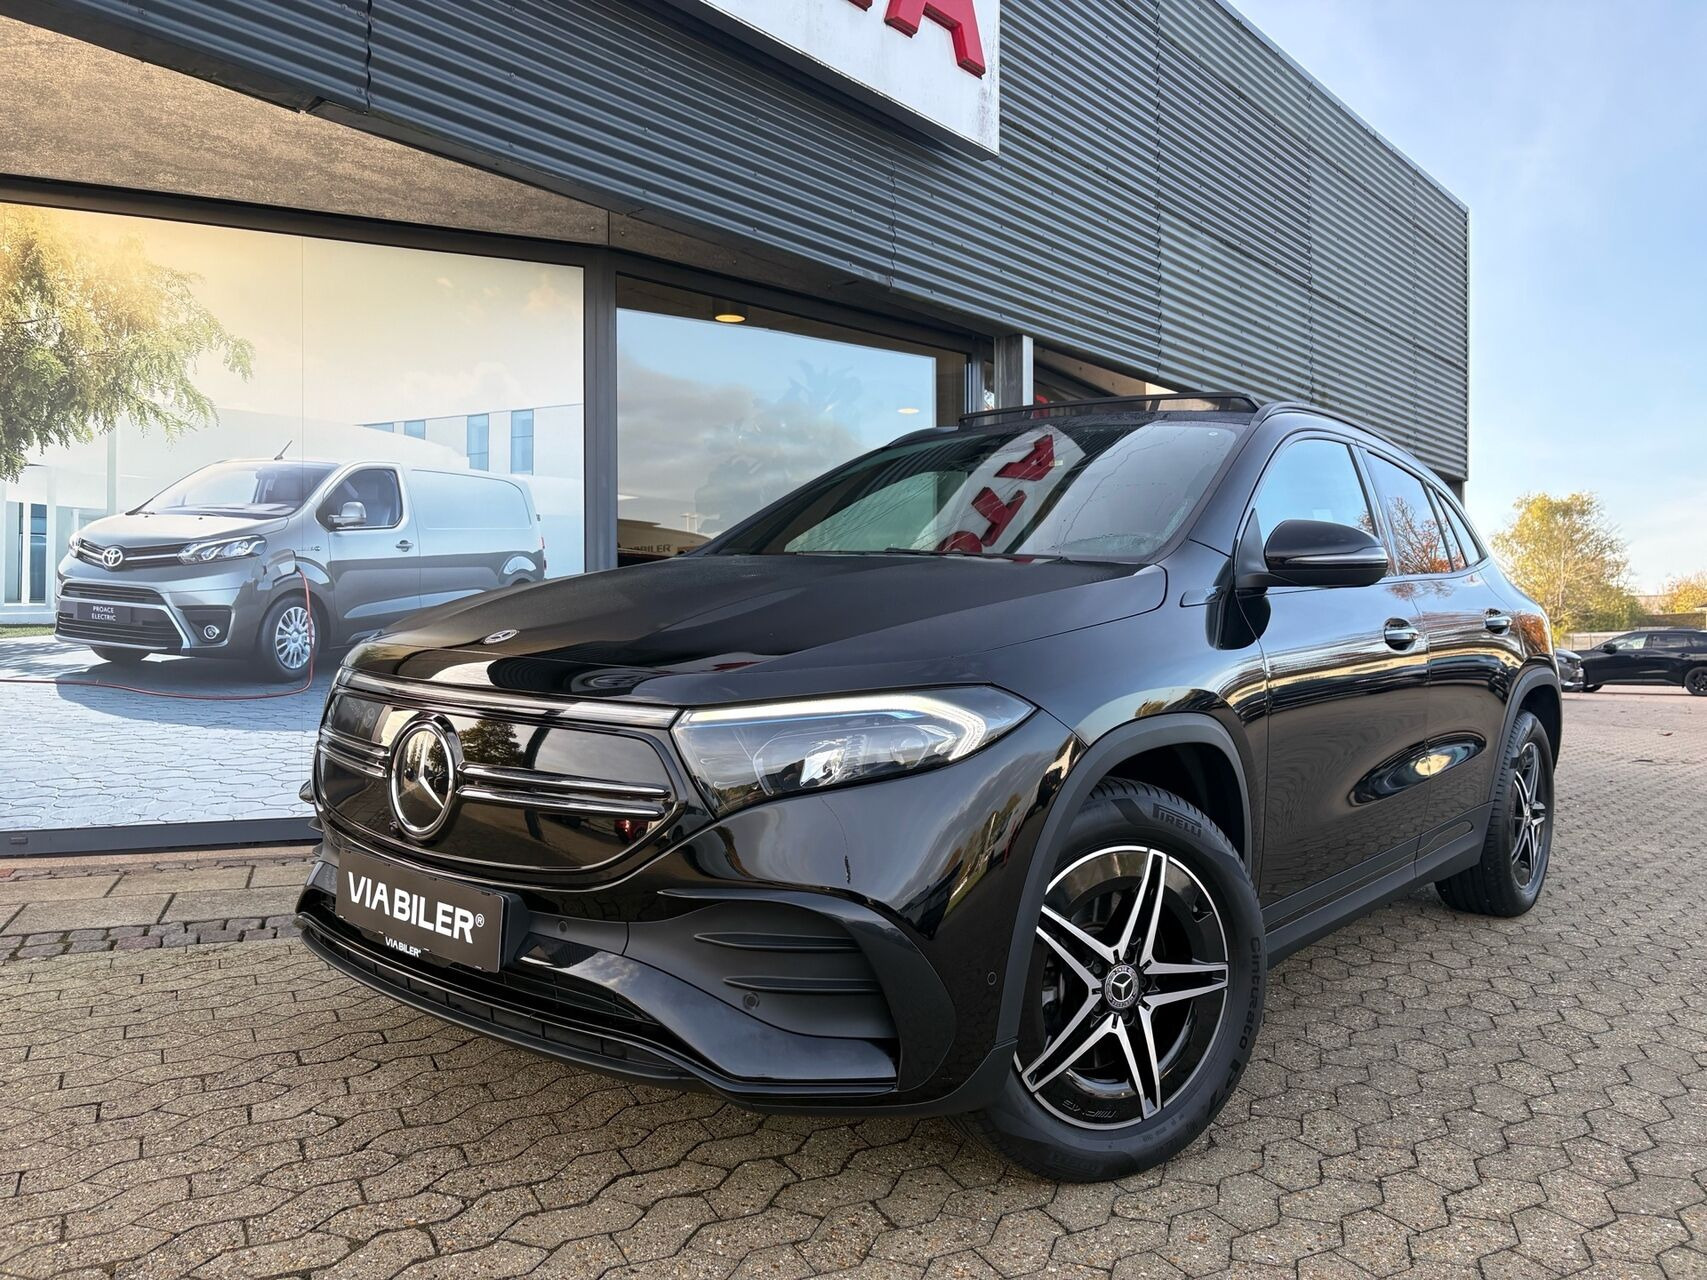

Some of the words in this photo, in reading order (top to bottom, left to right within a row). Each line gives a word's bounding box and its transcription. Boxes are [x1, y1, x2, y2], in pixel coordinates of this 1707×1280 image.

[91, 613, 117, 621] ELECTRIC
[92, 605, 114, 613] PROACE
[1152, 803, 1202, 838] PIRELLI
[1239, 936, 1261, 1050] Cinturato
